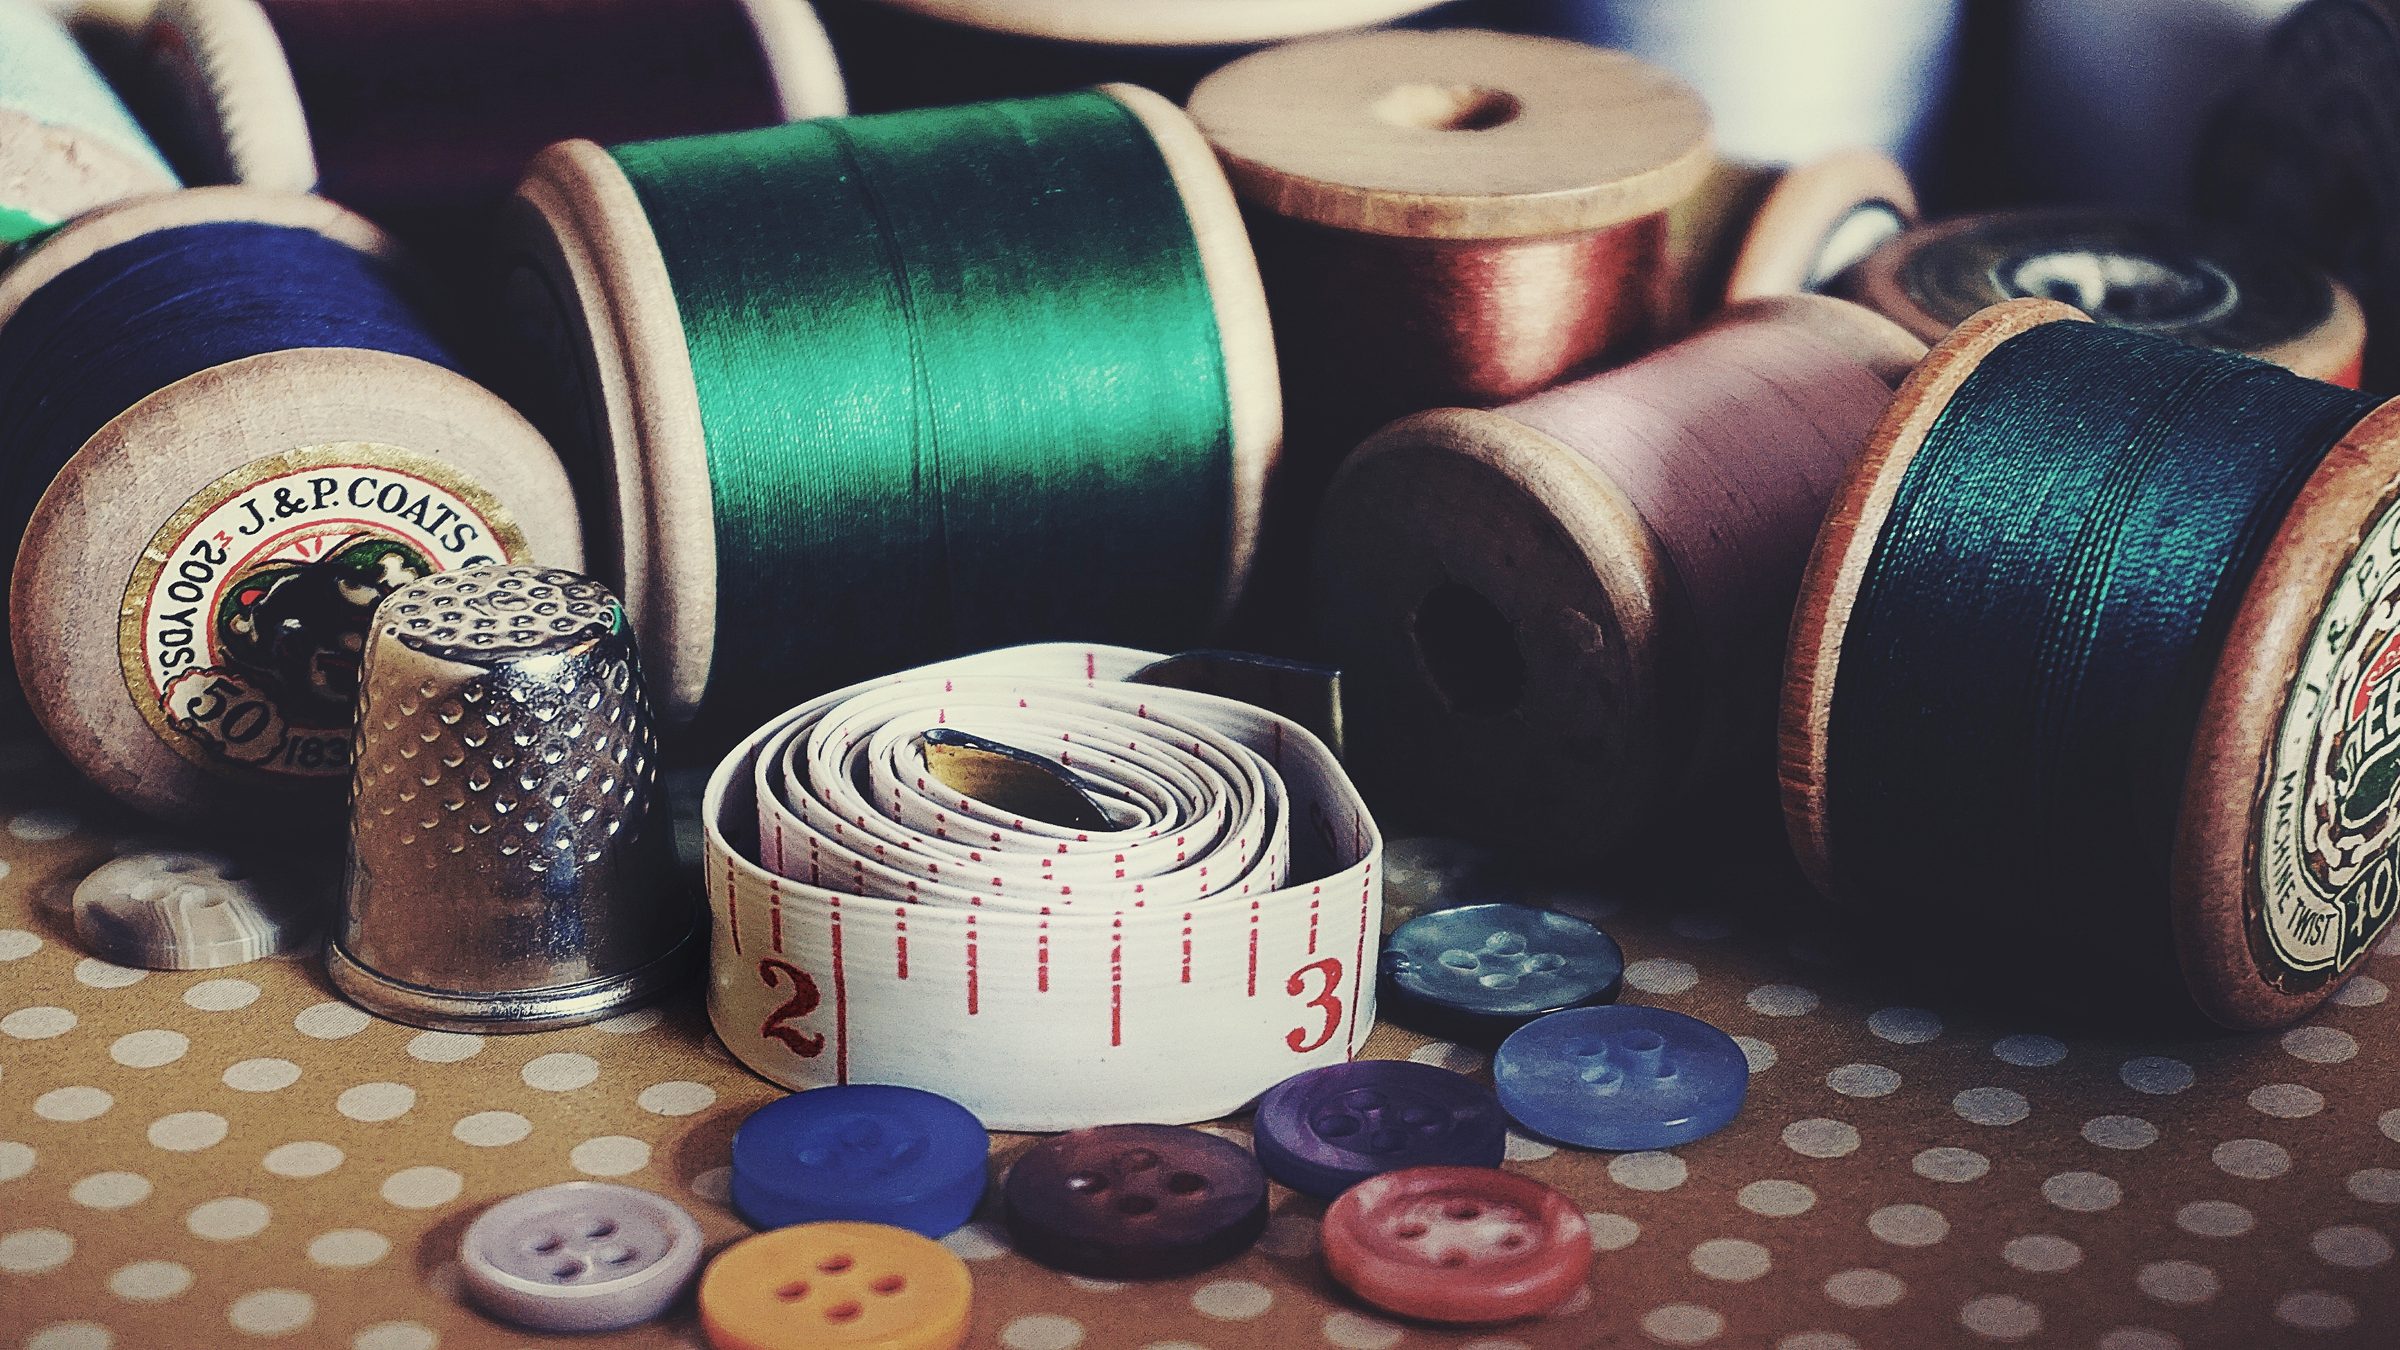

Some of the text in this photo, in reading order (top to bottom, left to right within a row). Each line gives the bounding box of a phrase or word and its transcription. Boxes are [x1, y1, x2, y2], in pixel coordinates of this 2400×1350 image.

[347, 476, 480, 554] COATS
[167, 539, 228, 603] 200
[157, 606, 198, 677] YDS.
[187, 677, 270, 743] 50
[2272, 769, 2338, 947] MACHINE TWIST
[758, 956, 826, 1059] 2
[1285, 957, 1343, 1053] 3
